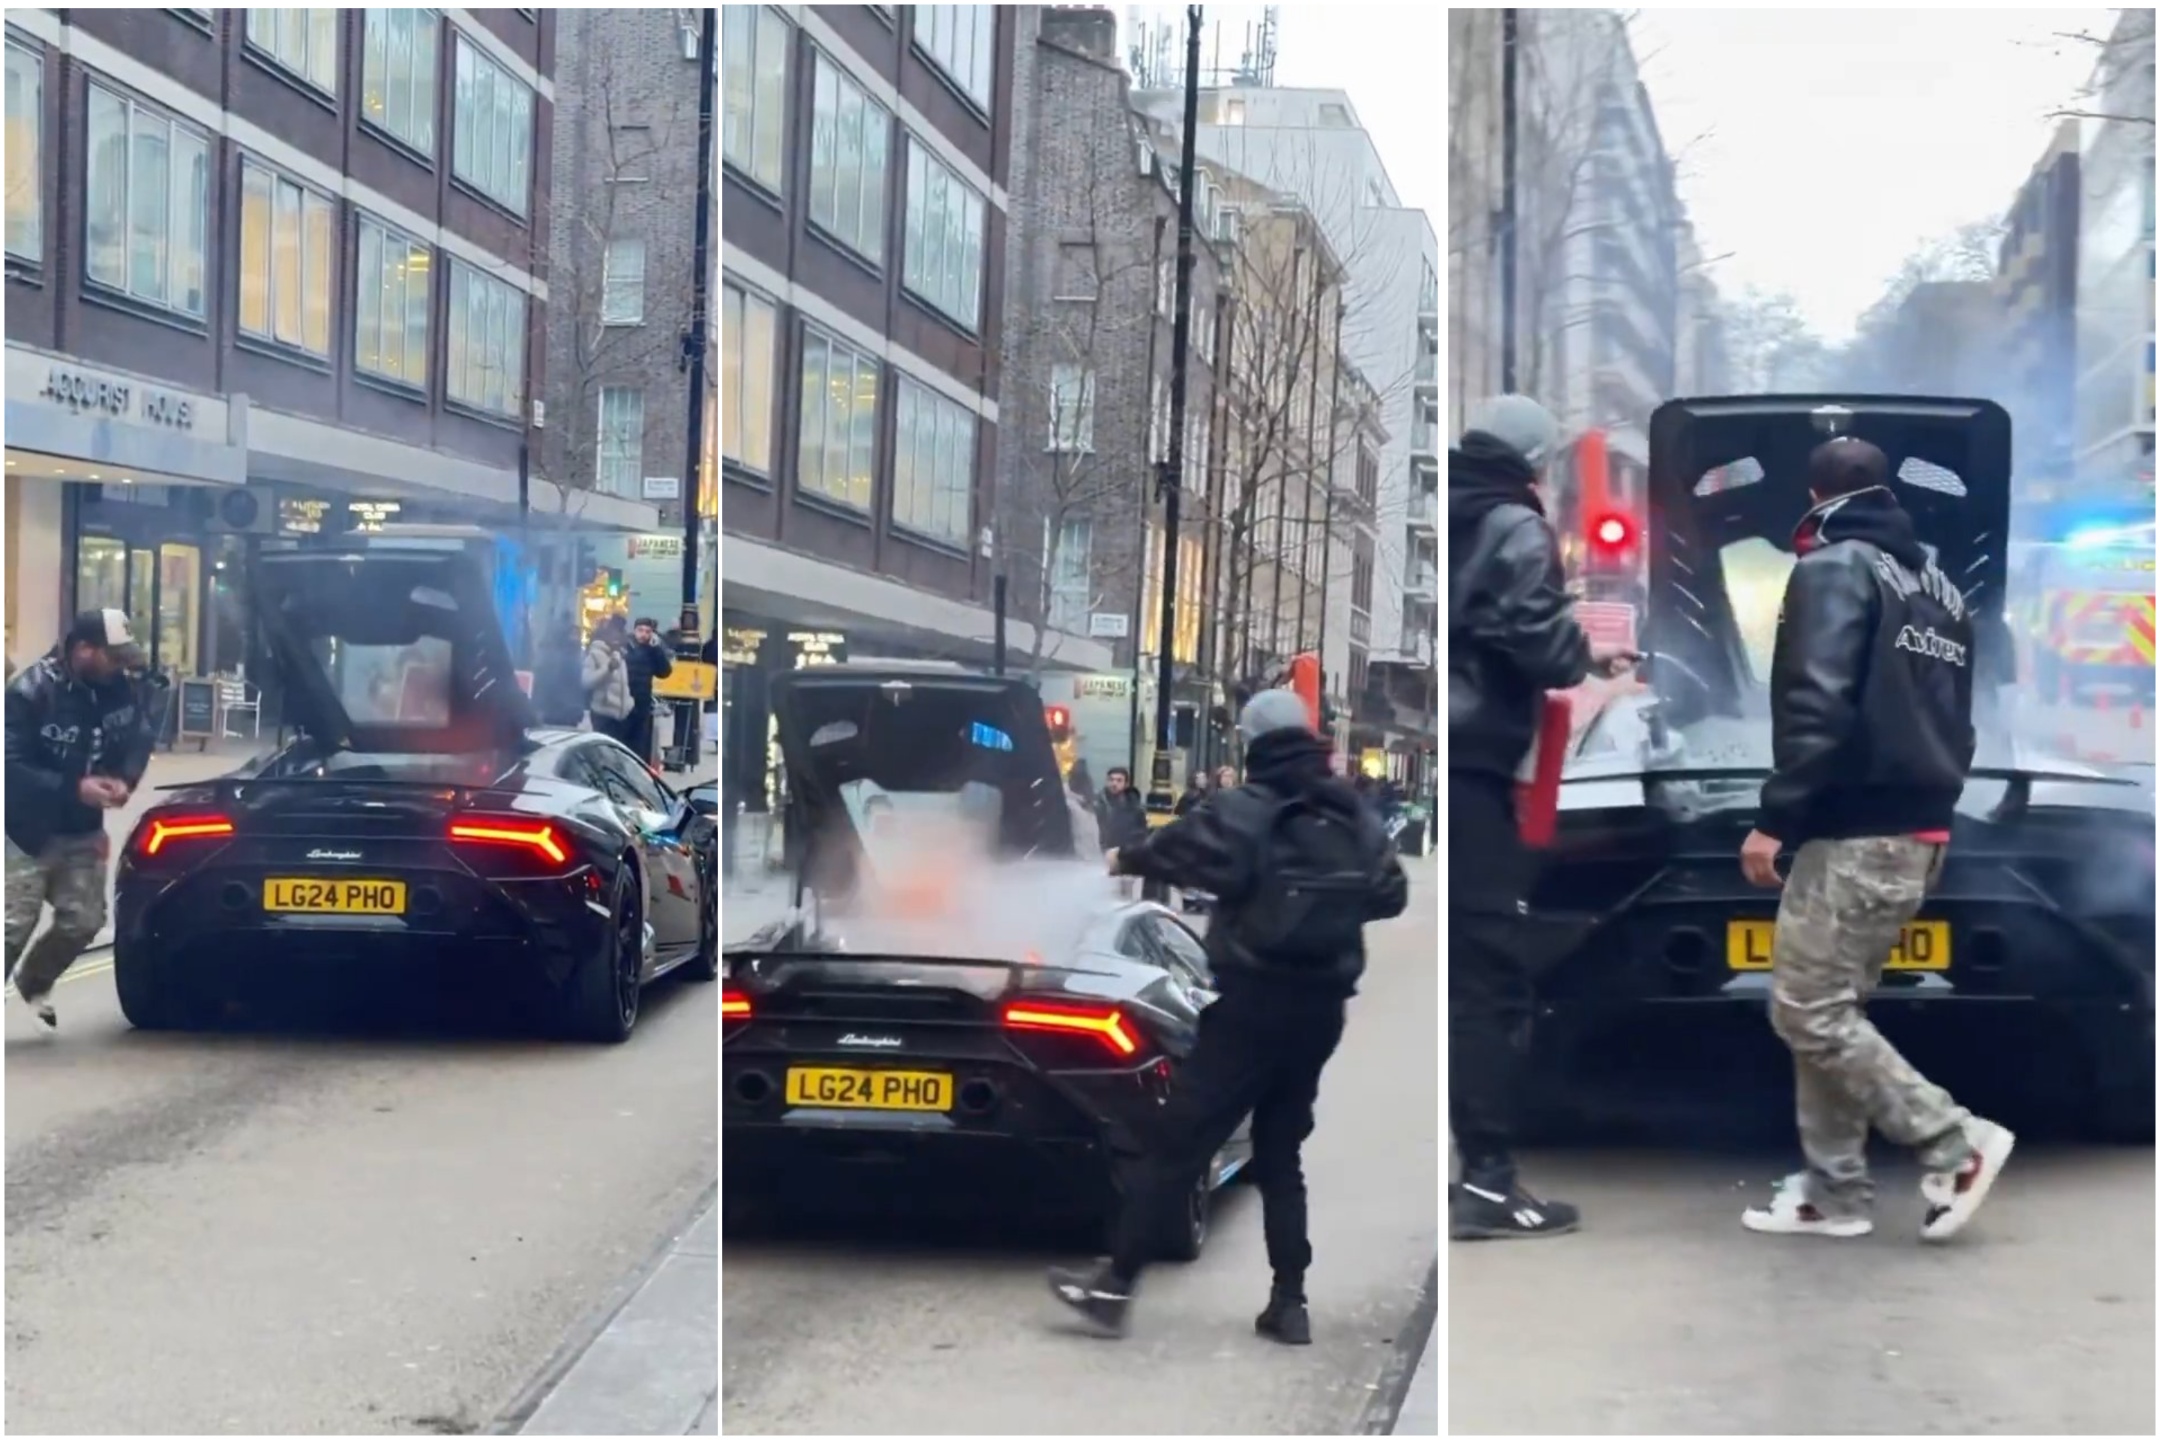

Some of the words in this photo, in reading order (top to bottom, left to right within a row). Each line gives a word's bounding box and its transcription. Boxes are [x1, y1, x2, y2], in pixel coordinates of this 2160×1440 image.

[275, 884, 339, 907] LG24
[346, 885, 395, 909] PHO
[800, 1073, 873, 1102] LG24
[883, 1076, 940, 1105] PHO
